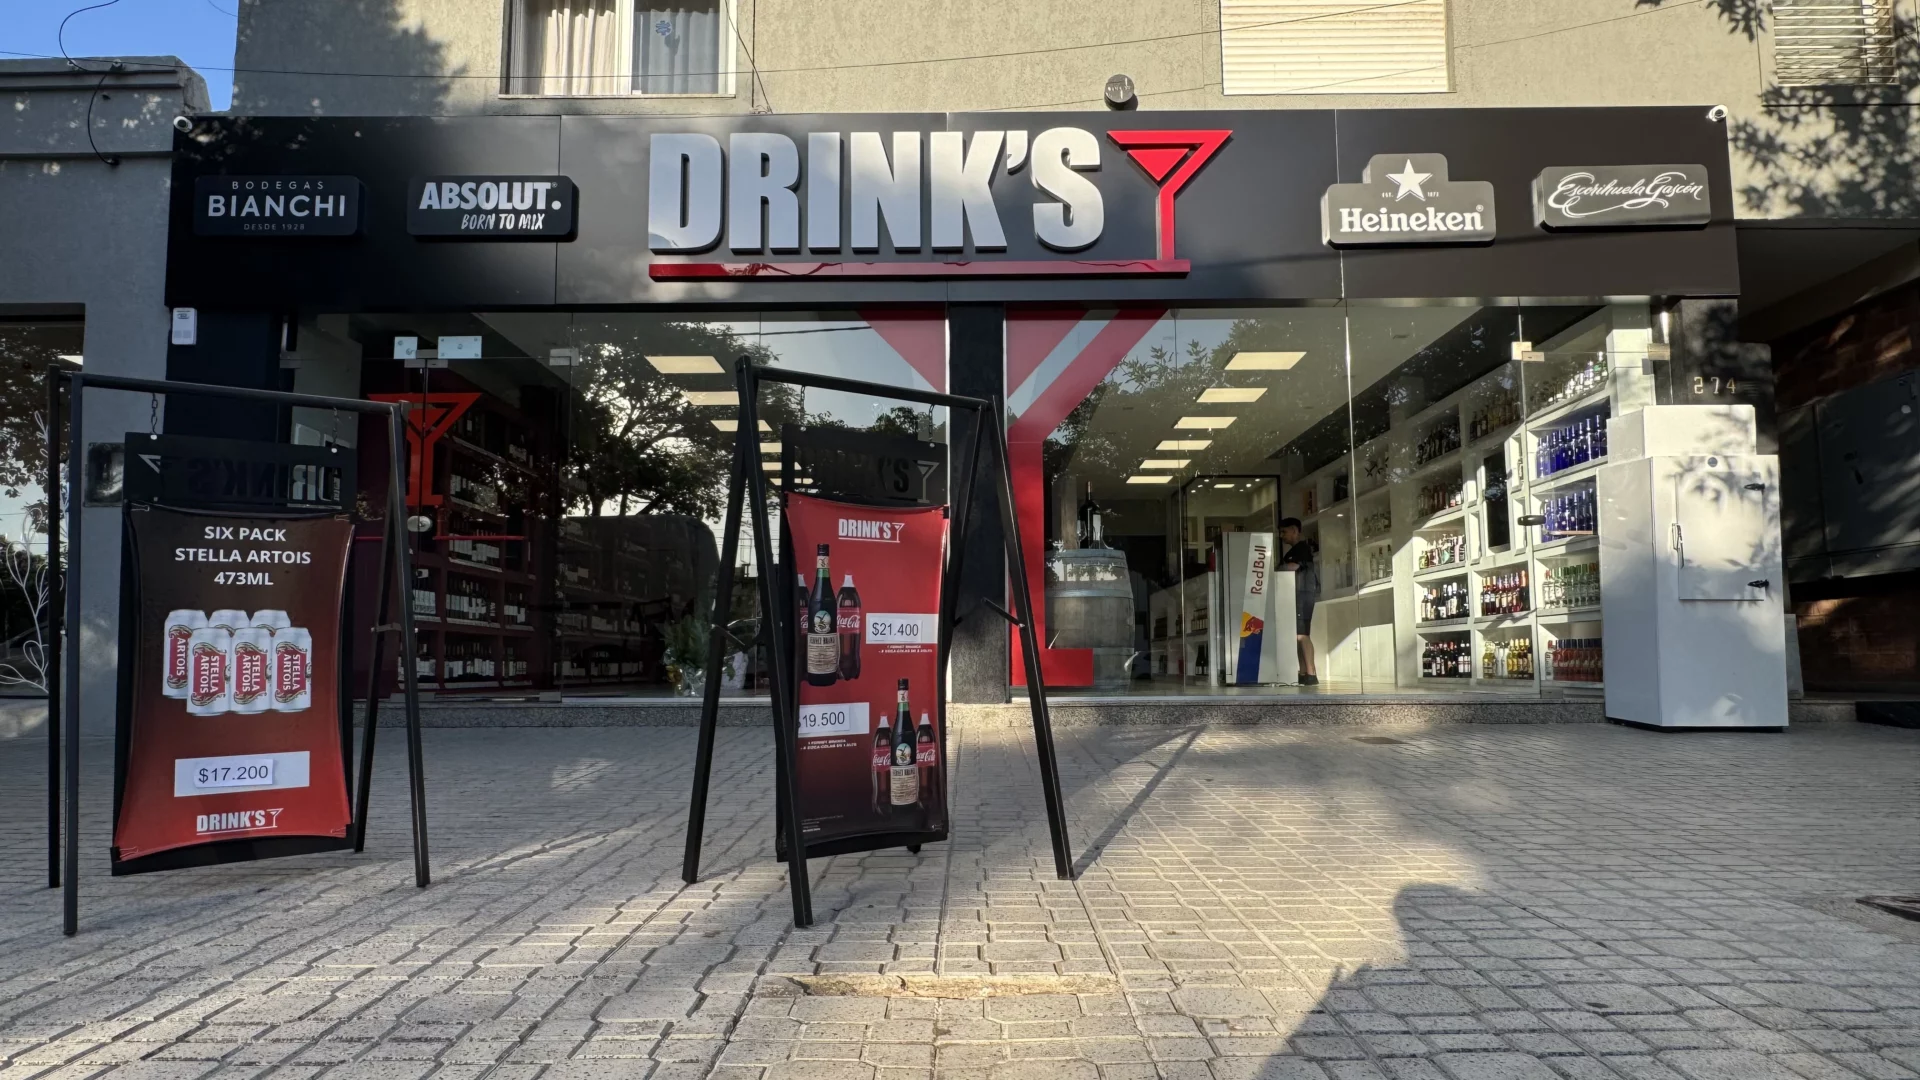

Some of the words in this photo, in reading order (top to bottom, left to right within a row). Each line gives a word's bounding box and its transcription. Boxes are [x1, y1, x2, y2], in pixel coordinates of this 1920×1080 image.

[232, 181, 324, 190] BODEGAS
[648, 127, 1104, 253] DRINK'S
[1548, 172, 1646, 214] Escorihuela
[1645, 172, 1704, 209] Gascón
[208, 195, 346, 217] BIANCHI
[281, 223, 305, 231] 1928
[461, 213, 496, 230] BORN
[499, 213, 516, 230] TO
[518, 213, 545, 231] MIX
[1339, 206, 1484, 233] Heineken
[1693, 376, 1737, 395] 274
[204, 526, 234, 540] SIX
[239, 527, 287, 542] PACK
[838, 518, 892, 540] DRINK'S
[175, 548, 242, 563] STELLA
[246, 549, 312, 564] ARTOIS
[1253, 545, 1267, 570] Bull
[213, 571, 274, 586] 473ML
[1250, 570, 1264, 595] Red
[871, 621, 919, 637] $21.400
[176, 637, 186, 677] ARTOIS
[200, 655, 210, 694] ARTOIS
[210, 655, 220, 693] STELLA
[242, 654, 252, 693] ARTOIS
[252, 654, 261, 692] STELLA
[283, 653, 292, 691] ARTOIS
[292, 654, 301, 691] STELLA
[198, 765, 269, 784] $17.200
[196, 809, 266, 832] DRINK'S
